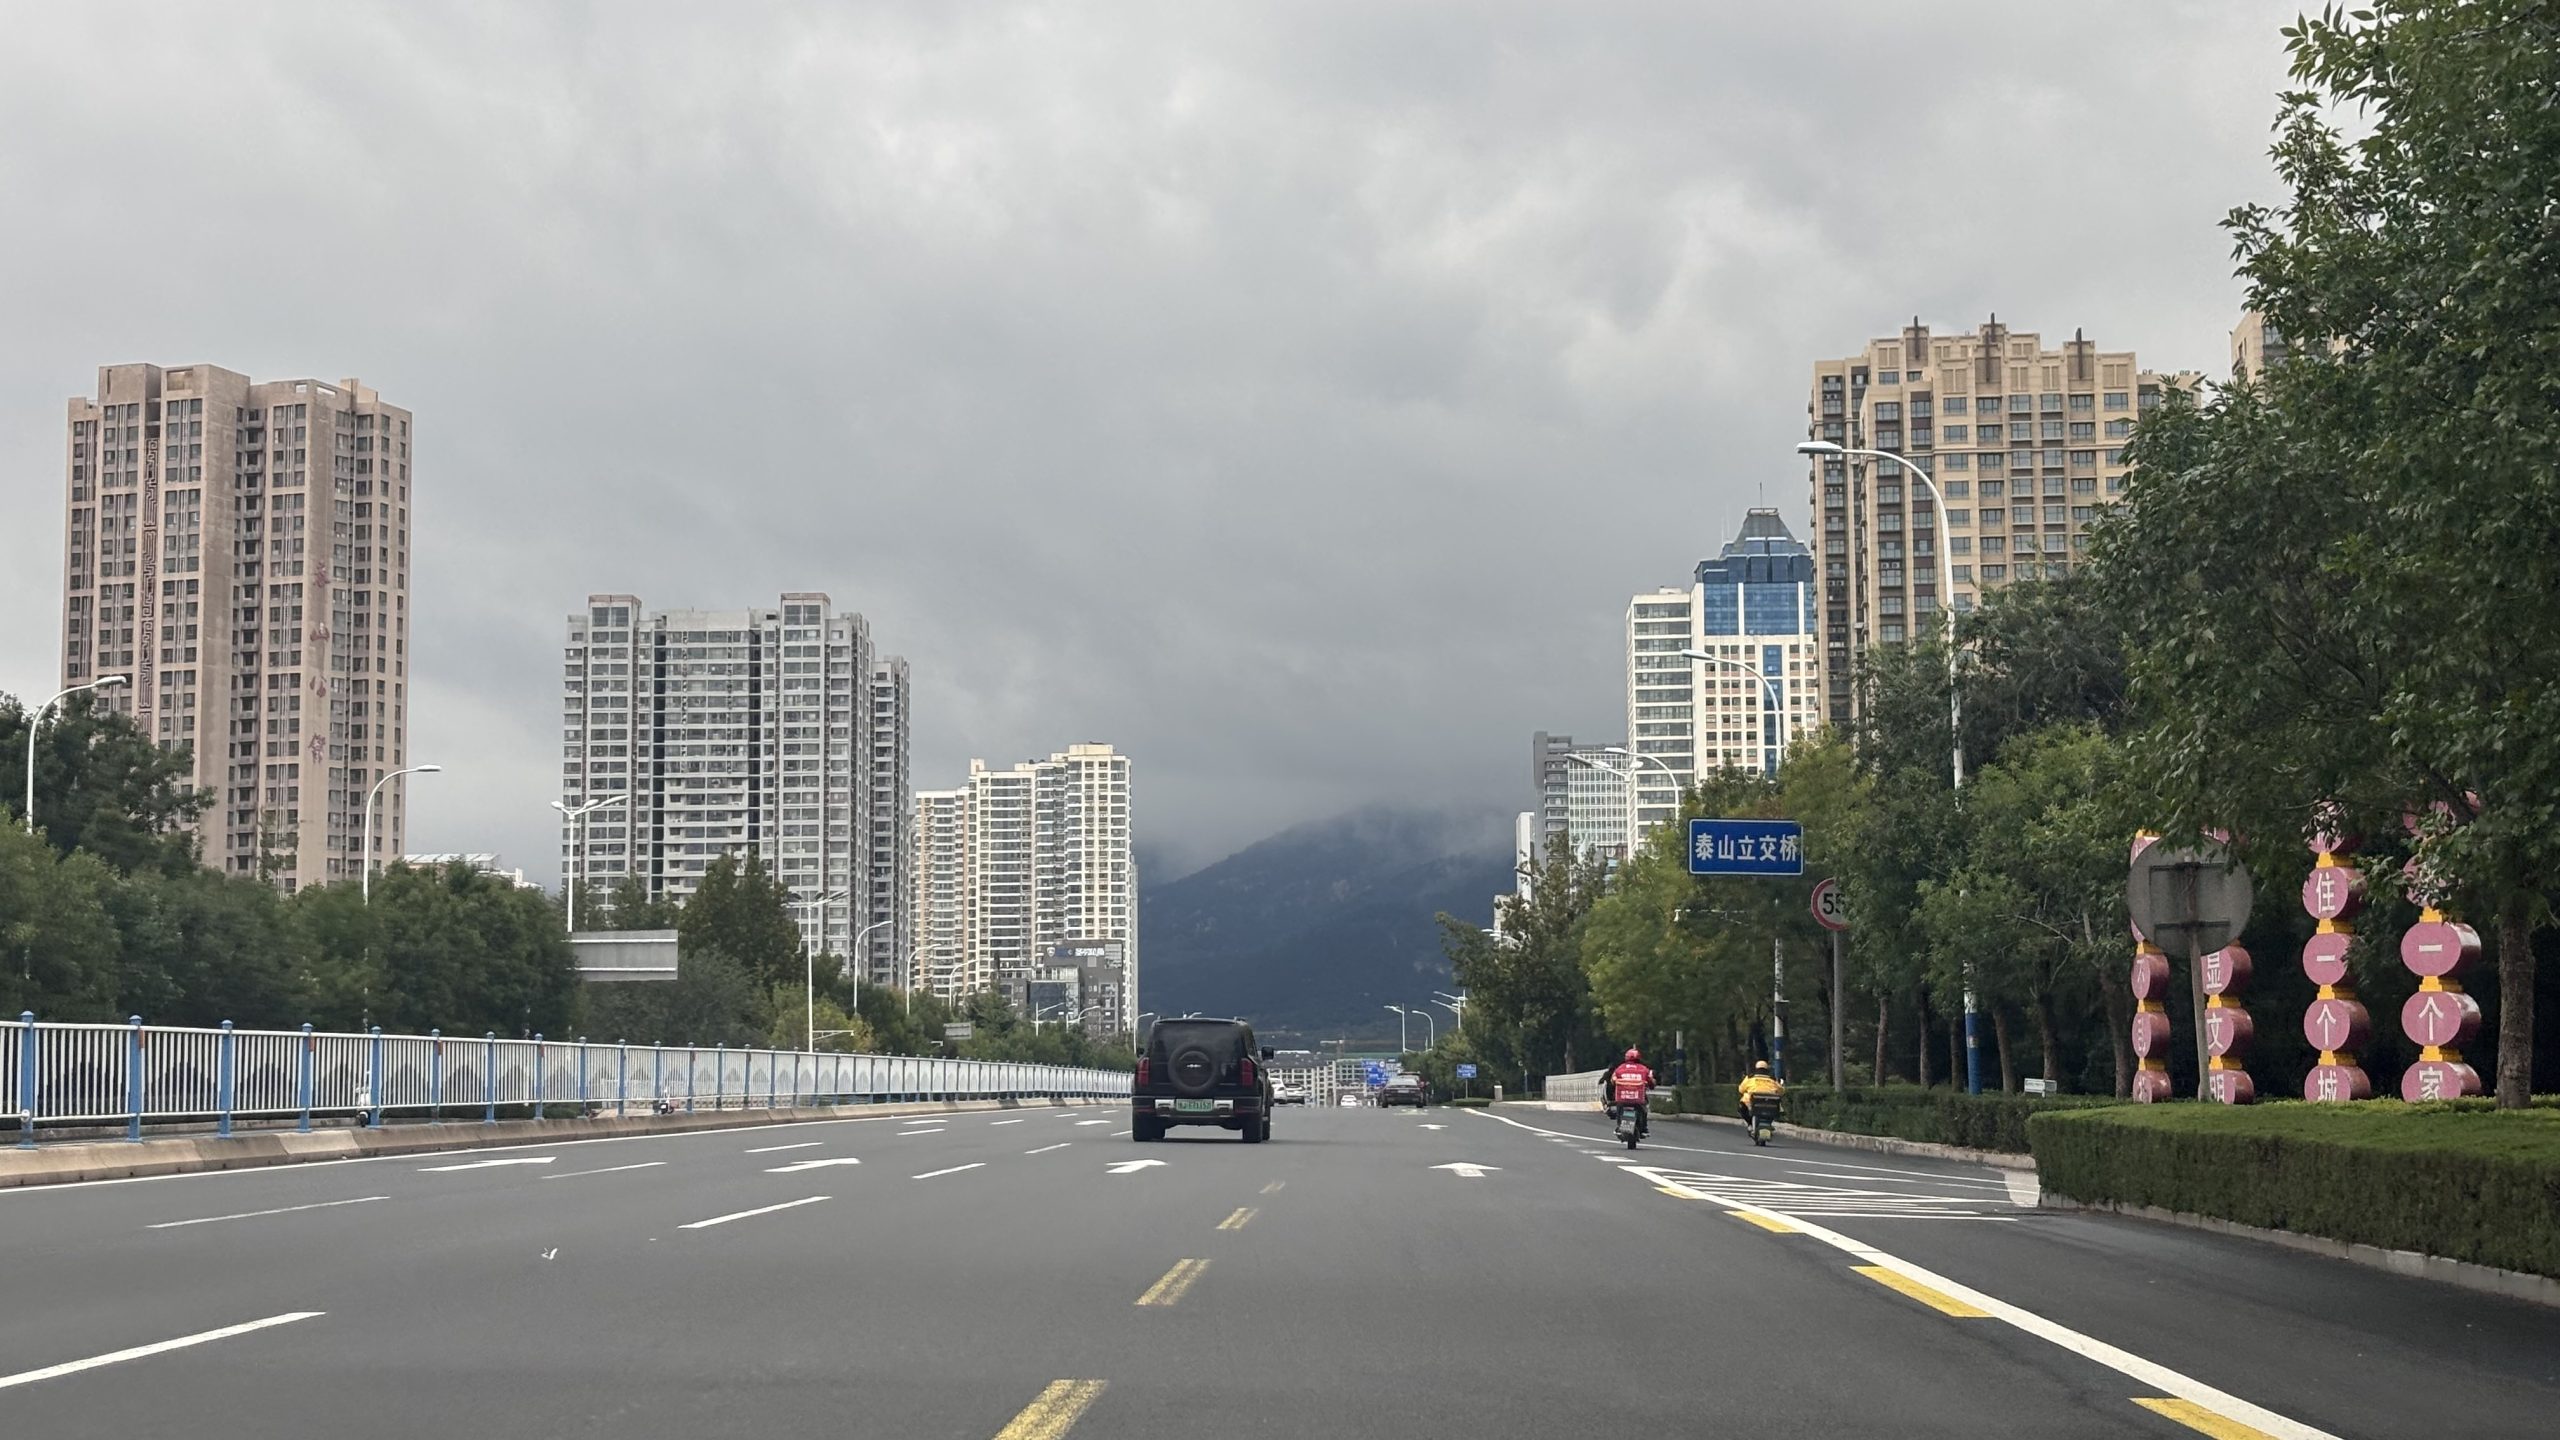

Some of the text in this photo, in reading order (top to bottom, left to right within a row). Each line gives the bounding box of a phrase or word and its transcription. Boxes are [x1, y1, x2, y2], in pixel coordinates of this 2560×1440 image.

[1695, 832, 1799, 862] 泰山立交桥
[2316, 834, 2338, 1101] 住一个城
[2418, 905, 2445, 1100] 一个家
